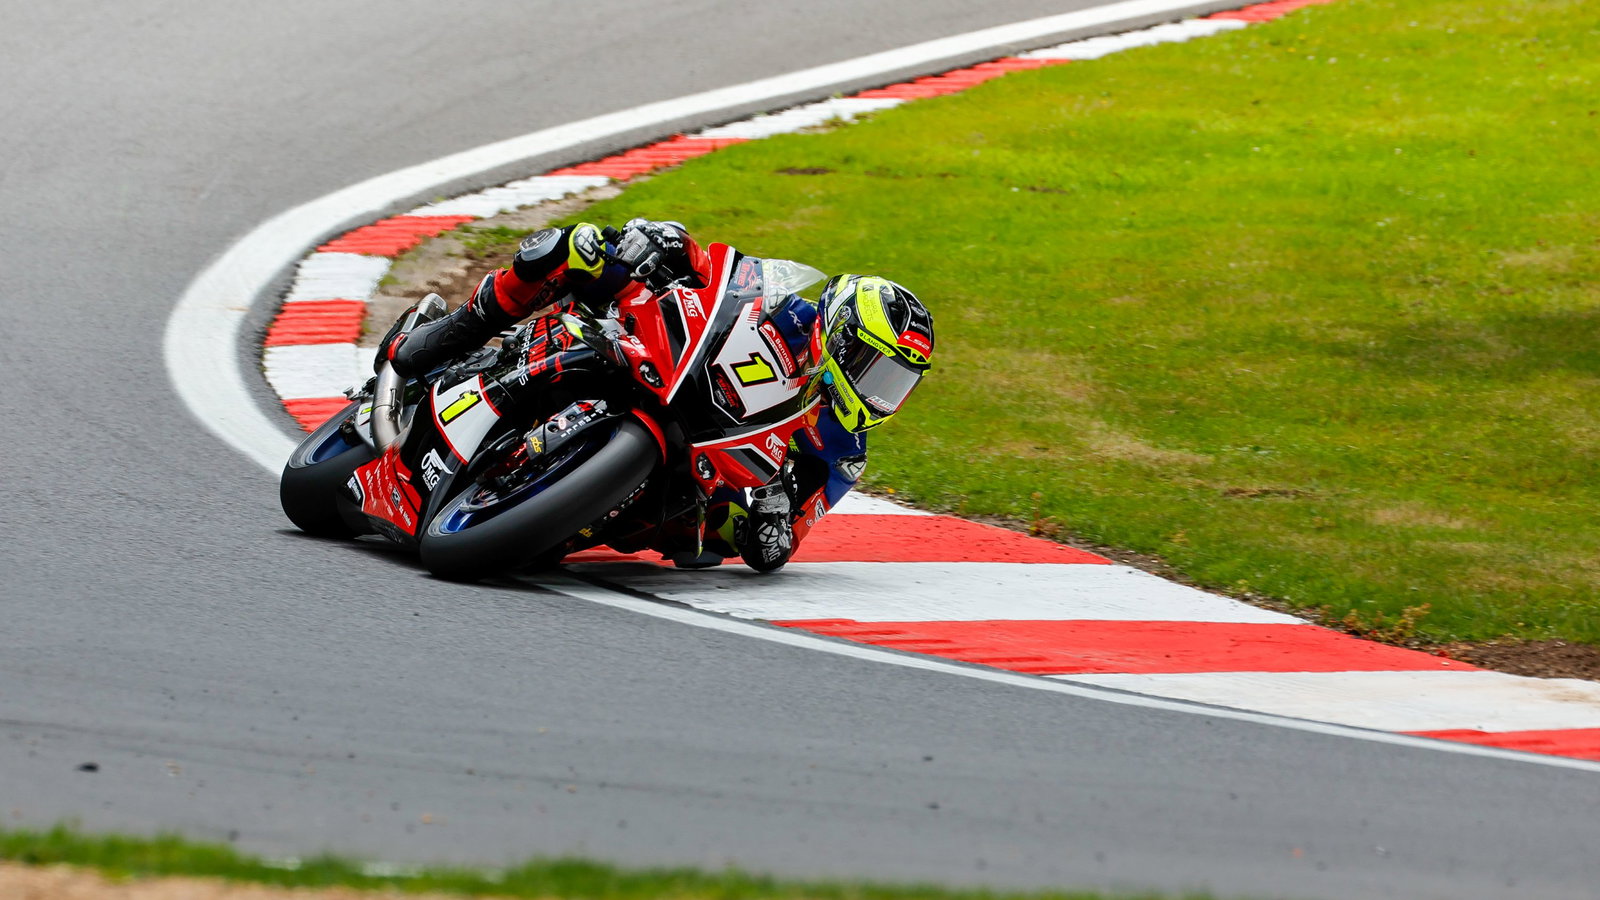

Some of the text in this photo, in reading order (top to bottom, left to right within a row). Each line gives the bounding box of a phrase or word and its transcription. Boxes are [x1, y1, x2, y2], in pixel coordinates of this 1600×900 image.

[682, 288, 699, 318] OMG
[731, 353, 778, 387] 1
[774, 337, 794, 374] Bennetts
[438, 389, 483, 427] 1
[530, 436, 544, 453] sbs
[765, 434, 783, 460] OMG
[421, 450, 441, 487] OMG
